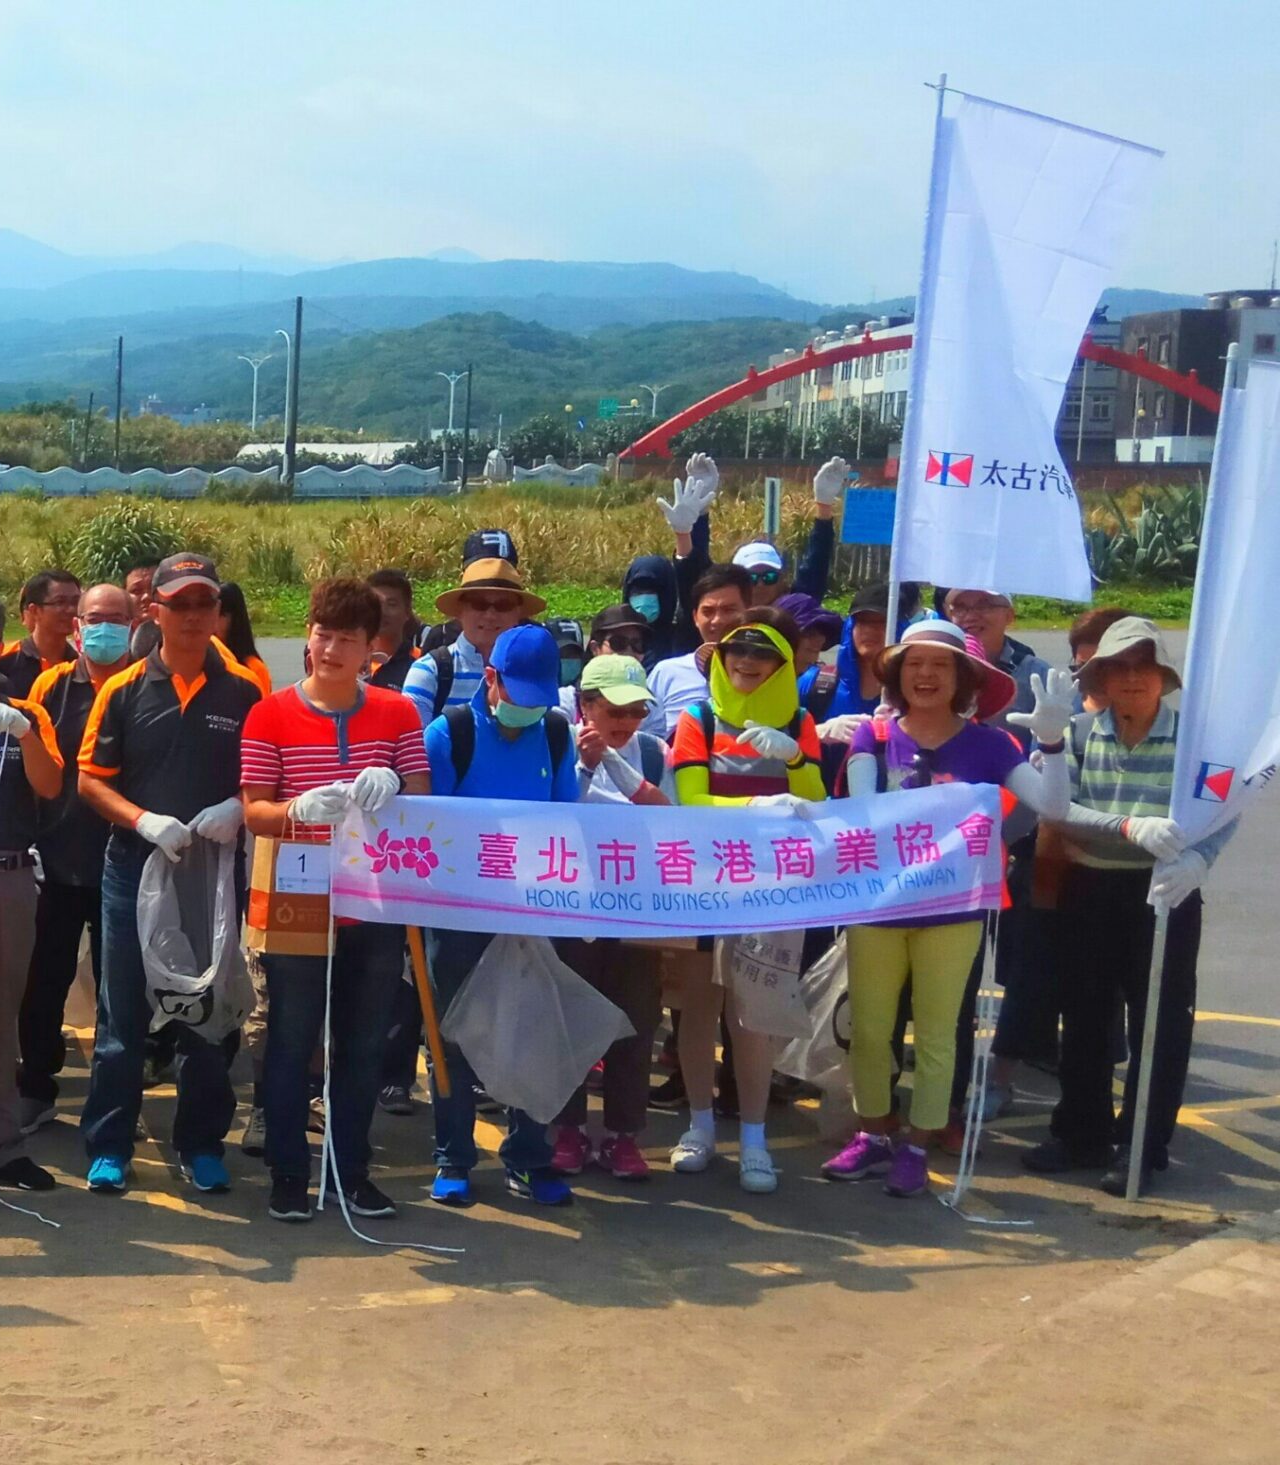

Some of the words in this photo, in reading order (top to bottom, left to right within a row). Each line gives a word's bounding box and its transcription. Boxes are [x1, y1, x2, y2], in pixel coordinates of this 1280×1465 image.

[298, 853, 306, 873] 1
[477, 812, 995, 885] 臺北市香港商業協會
[526, 888, 580, 909] HONG
[590, 892, 642, 911] KONG
[653, 891, 729, 911] BUSINESS
[742, 881, 859, 908] ASSOCIATION
[868, 879, 885, 895] IN
[895, 868, 956, 890] TAIWAN
